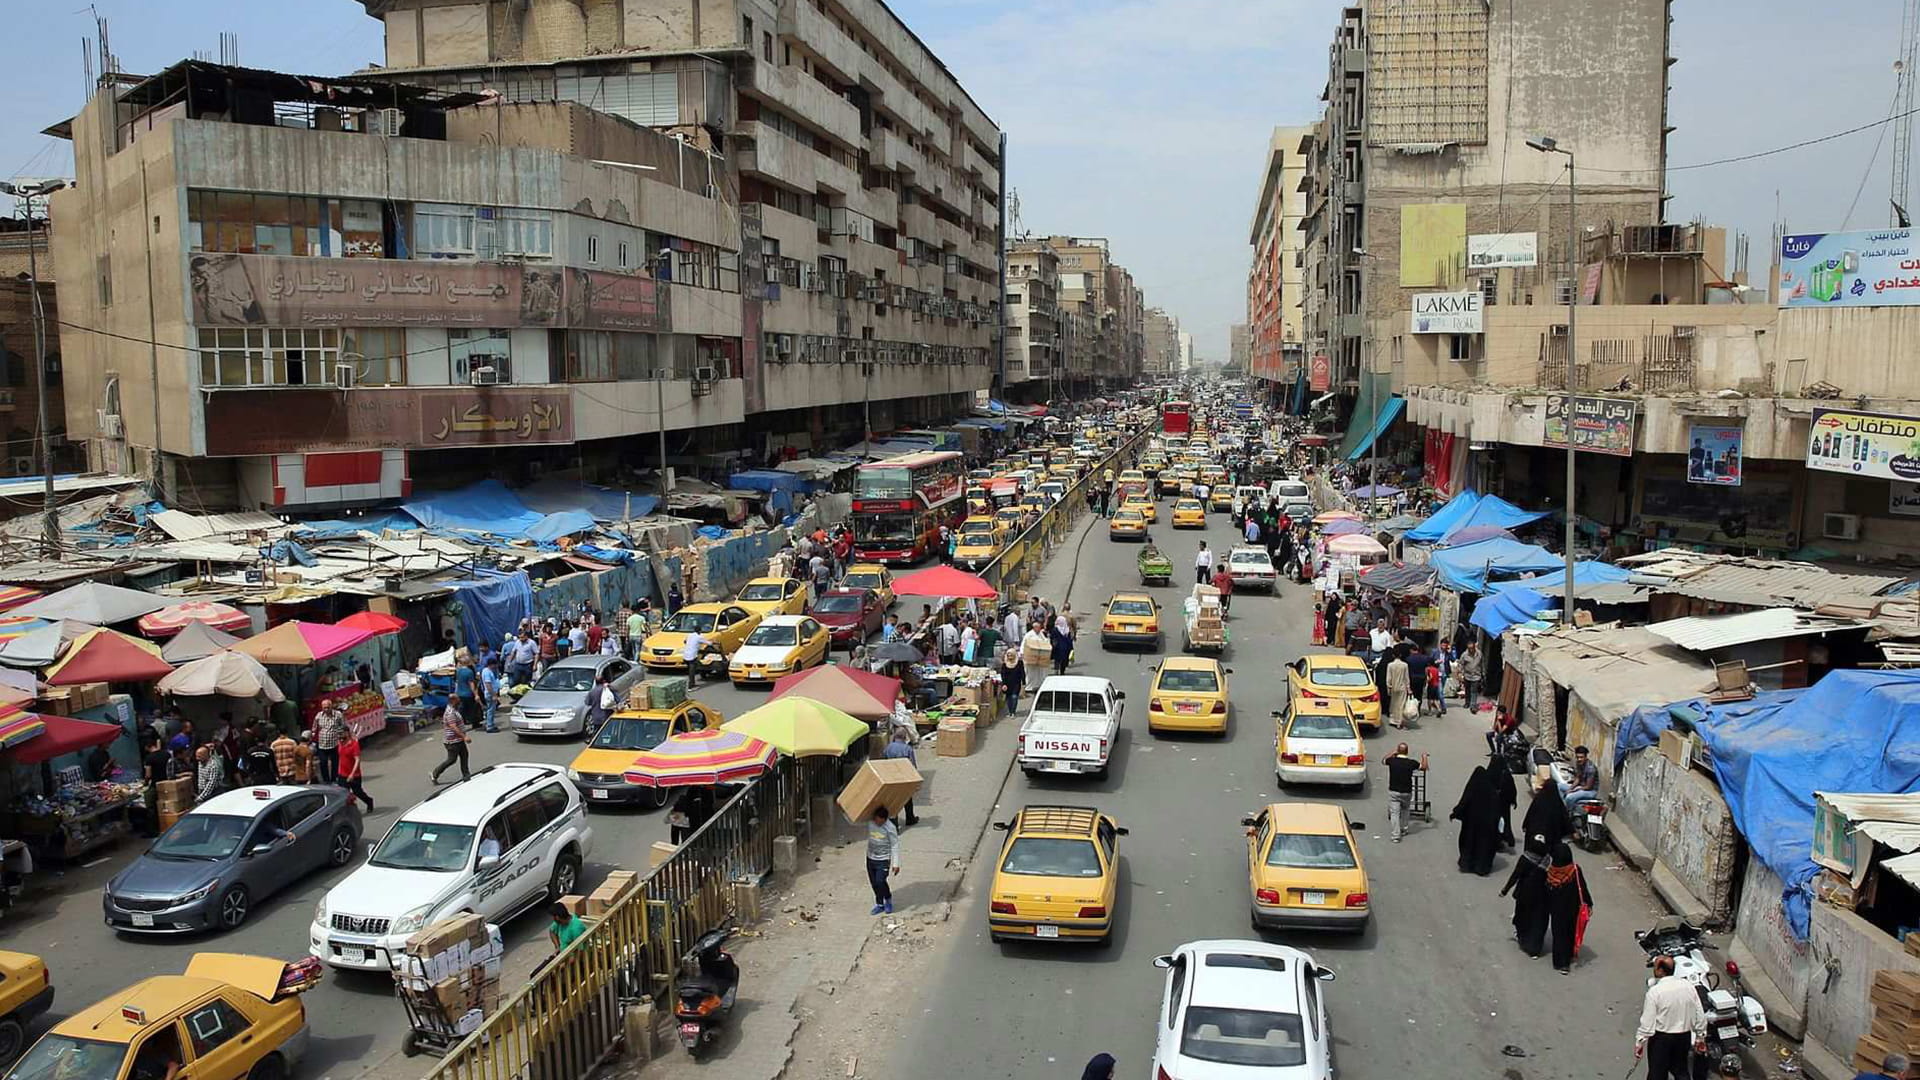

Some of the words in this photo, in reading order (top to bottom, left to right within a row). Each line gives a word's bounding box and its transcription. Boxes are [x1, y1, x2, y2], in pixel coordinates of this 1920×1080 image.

[1890, 230, 1910, 240] فاين
[1786, 237, 1810, 254] فاين
[1862, 248, 1886, 258] الخبراء
[1887, 247, 1909, 258] اختيار
[267, 269, 355, 300] التجاري
[361, 271, 440, 302] الكناني
[1560, 400, 1604, 418] البغداي
[1606, 404, 1632, 421] ركن
[432, 397, 561, 440] الأوسكار
[1845, 417, 1917, 438] منظفات
[1034, 740, 1091, 752] NISSAN
[479, 855, 540, 903] PRADO
